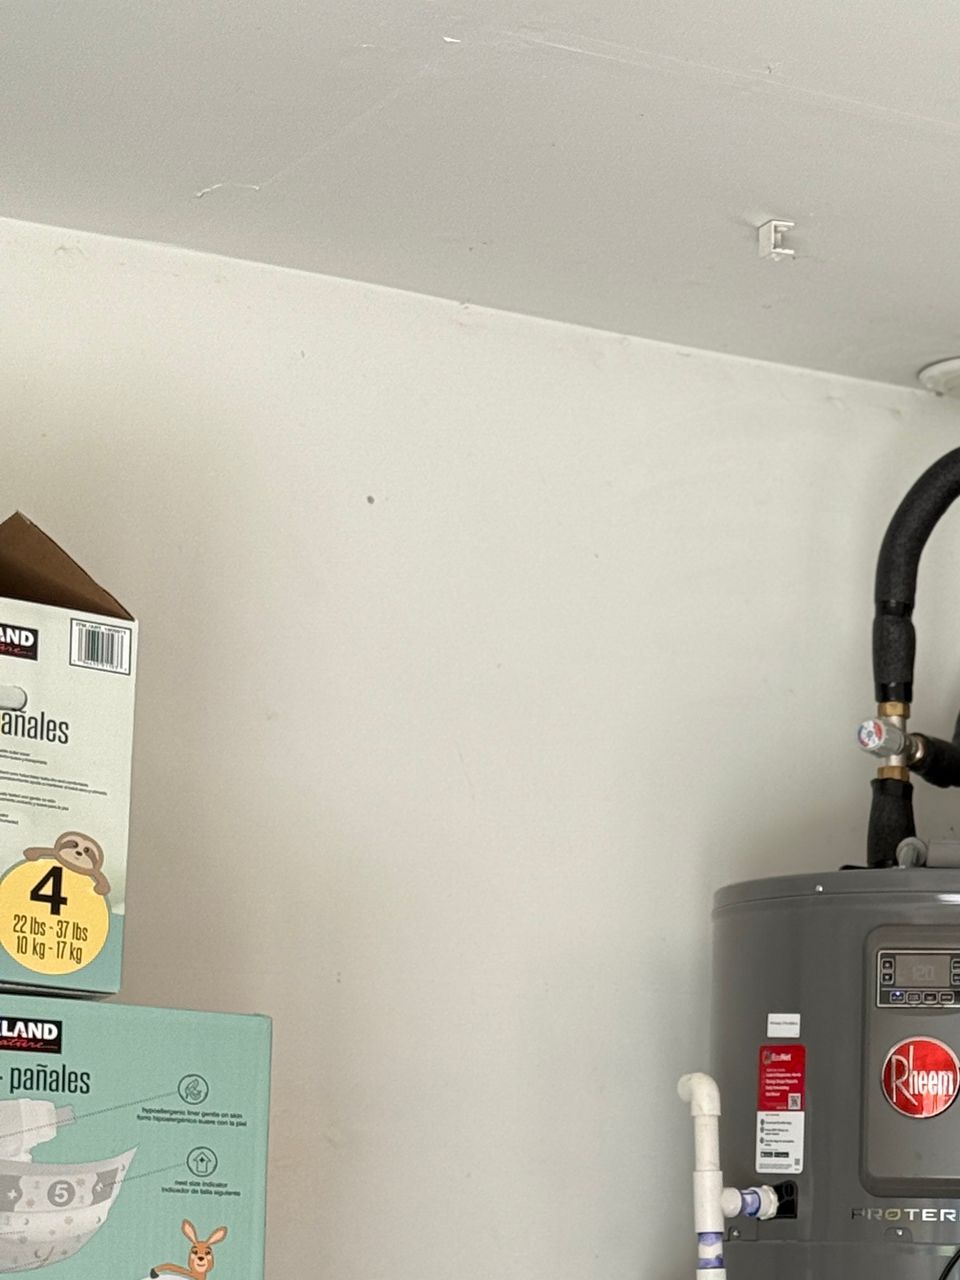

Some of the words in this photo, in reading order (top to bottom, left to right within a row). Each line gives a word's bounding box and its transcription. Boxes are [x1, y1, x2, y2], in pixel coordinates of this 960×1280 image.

[30, 866, 67, 915] 4
[13, 914, 27, 933] 22
[30, 916, 46, 936] lbs
[57, 920, 69, 938] 37
[72, 922, 88, 941] lbs
[17, 936, 27, 954] 10
[32, 937, 45, 960] kg
[57, 941, 67, 959] 17
[70, 942, 82, 964] kg
[10, 1063, 90, 1094] pañales
[891, 1045, 955, 1105] Rheem
[54, 1184, 68, 1202] 5
